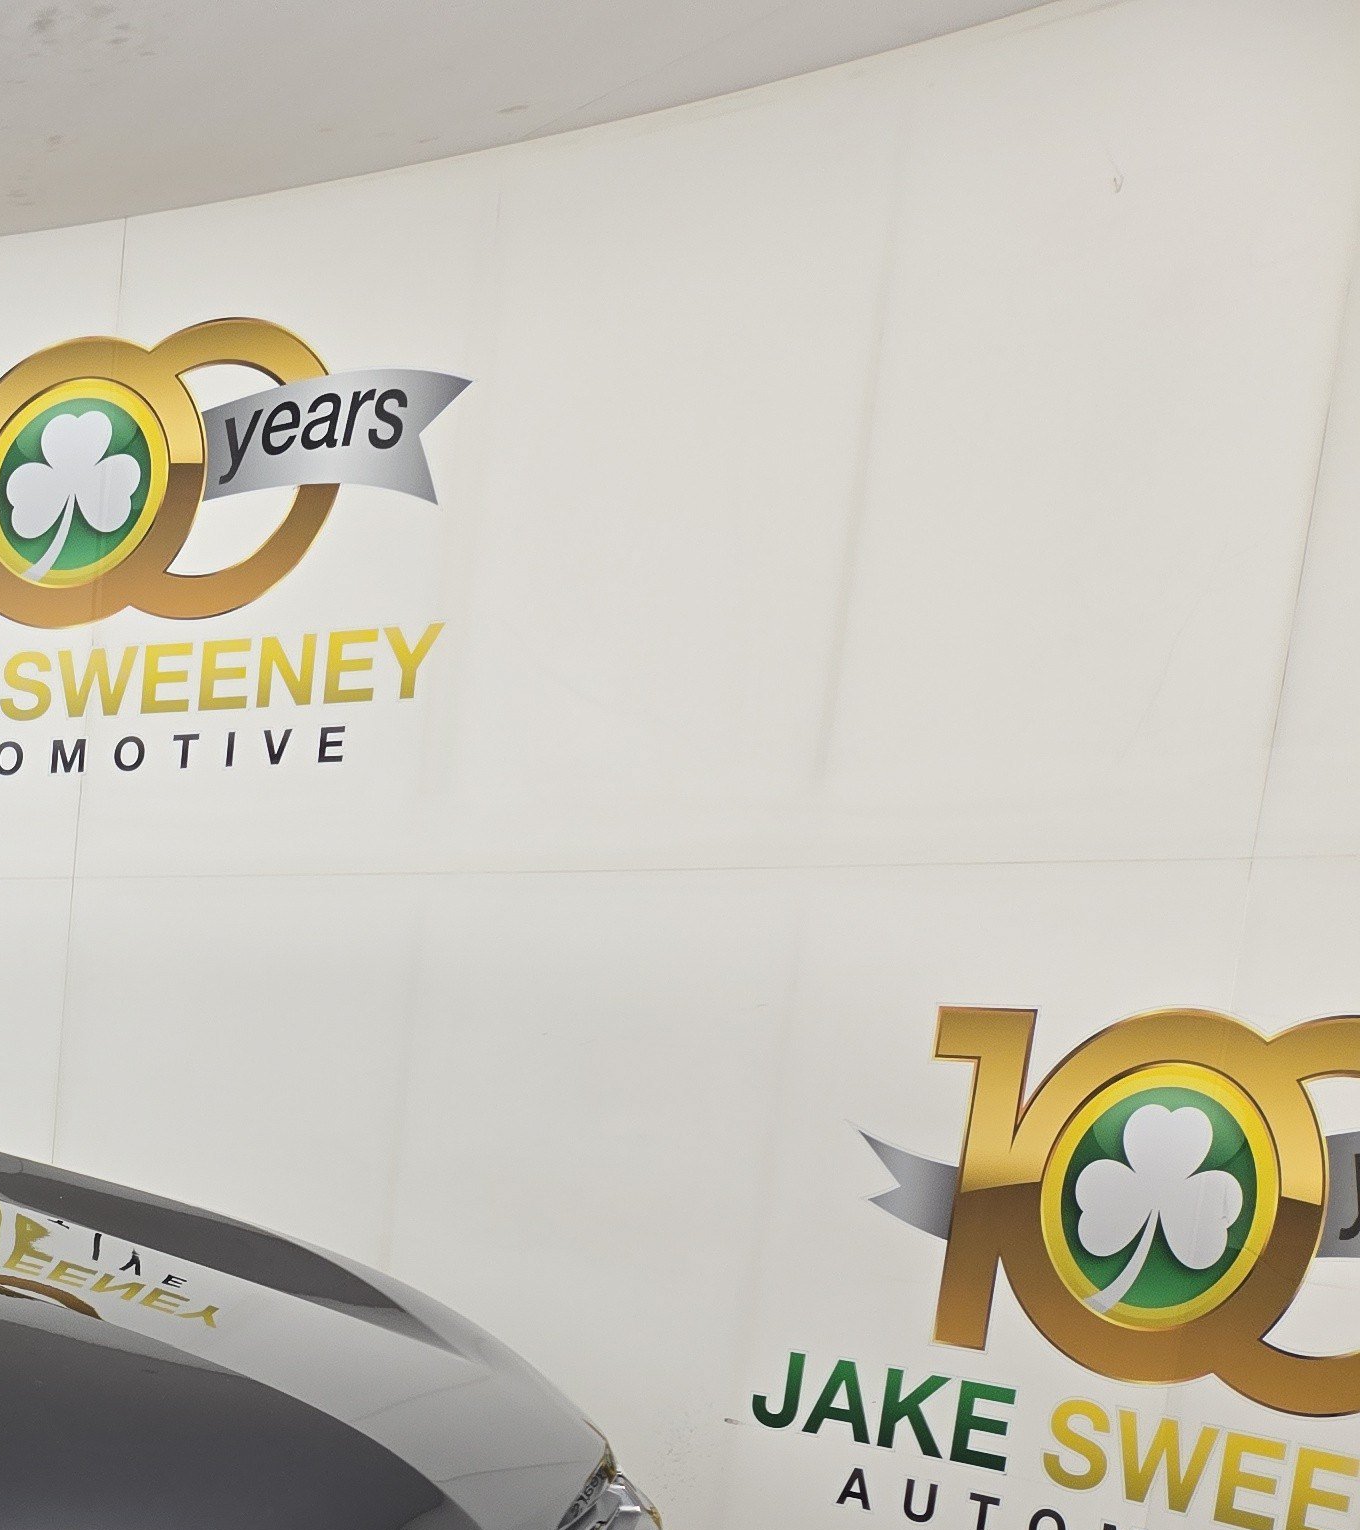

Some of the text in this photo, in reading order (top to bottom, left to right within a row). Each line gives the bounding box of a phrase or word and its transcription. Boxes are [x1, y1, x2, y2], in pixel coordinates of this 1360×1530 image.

[219, 387, 409, 486] years
[0, 622, 445, 722] SWEENEY
[752, 1352, 1016, 1472] JAKE
